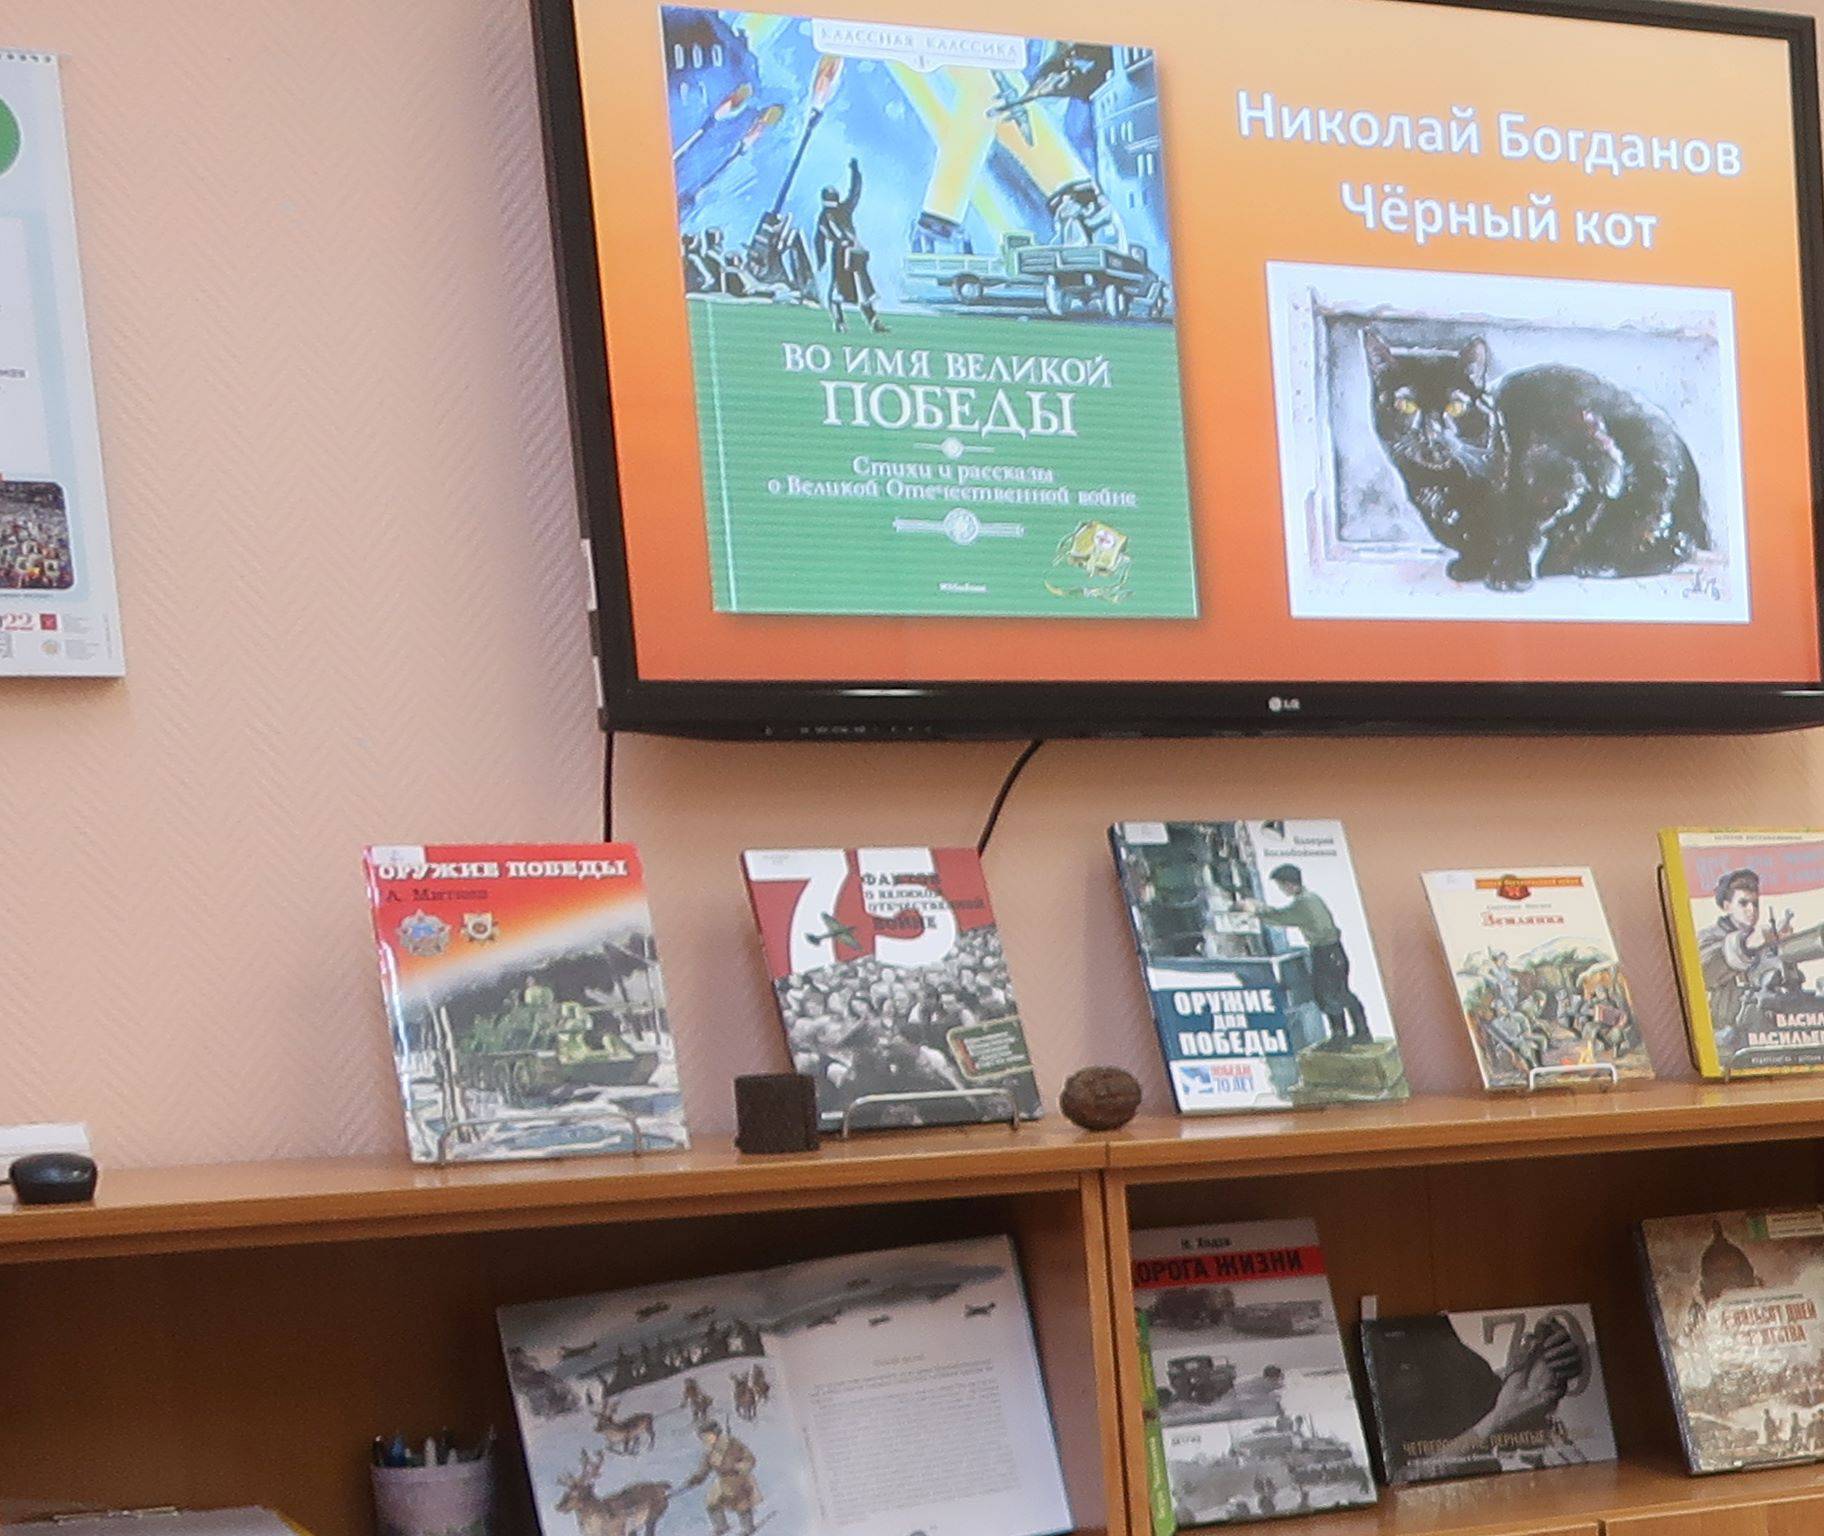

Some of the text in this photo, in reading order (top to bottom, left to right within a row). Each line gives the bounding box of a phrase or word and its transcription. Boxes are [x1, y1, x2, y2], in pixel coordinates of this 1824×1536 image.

[1235, 89, 1744, 178] Николай Богданов
[1339, 181, 1659, 250] Чёрный кот
[781, 342, 1114, 389] ВО ИМЯ ВЕЛИКОЙ
[819, 379, 1079, 441] ПОБЕДЫ
[852, 456, 1055, 485] Стихи и рассказы
[767, 475, 1139, 508] о Великой Отечественной войне
[378, 859, 629, 881] ОРУЖИЕ ПОБЕДЫ
[743, 847, 958, 977] 75
[1172, 987, 1277, 1017] ОРУЖИЕ
[1177, 1028, 1289, 1057] ПОБЕДЫ
[1213, 1249, 1304, 1277] ЖИЗНИ
